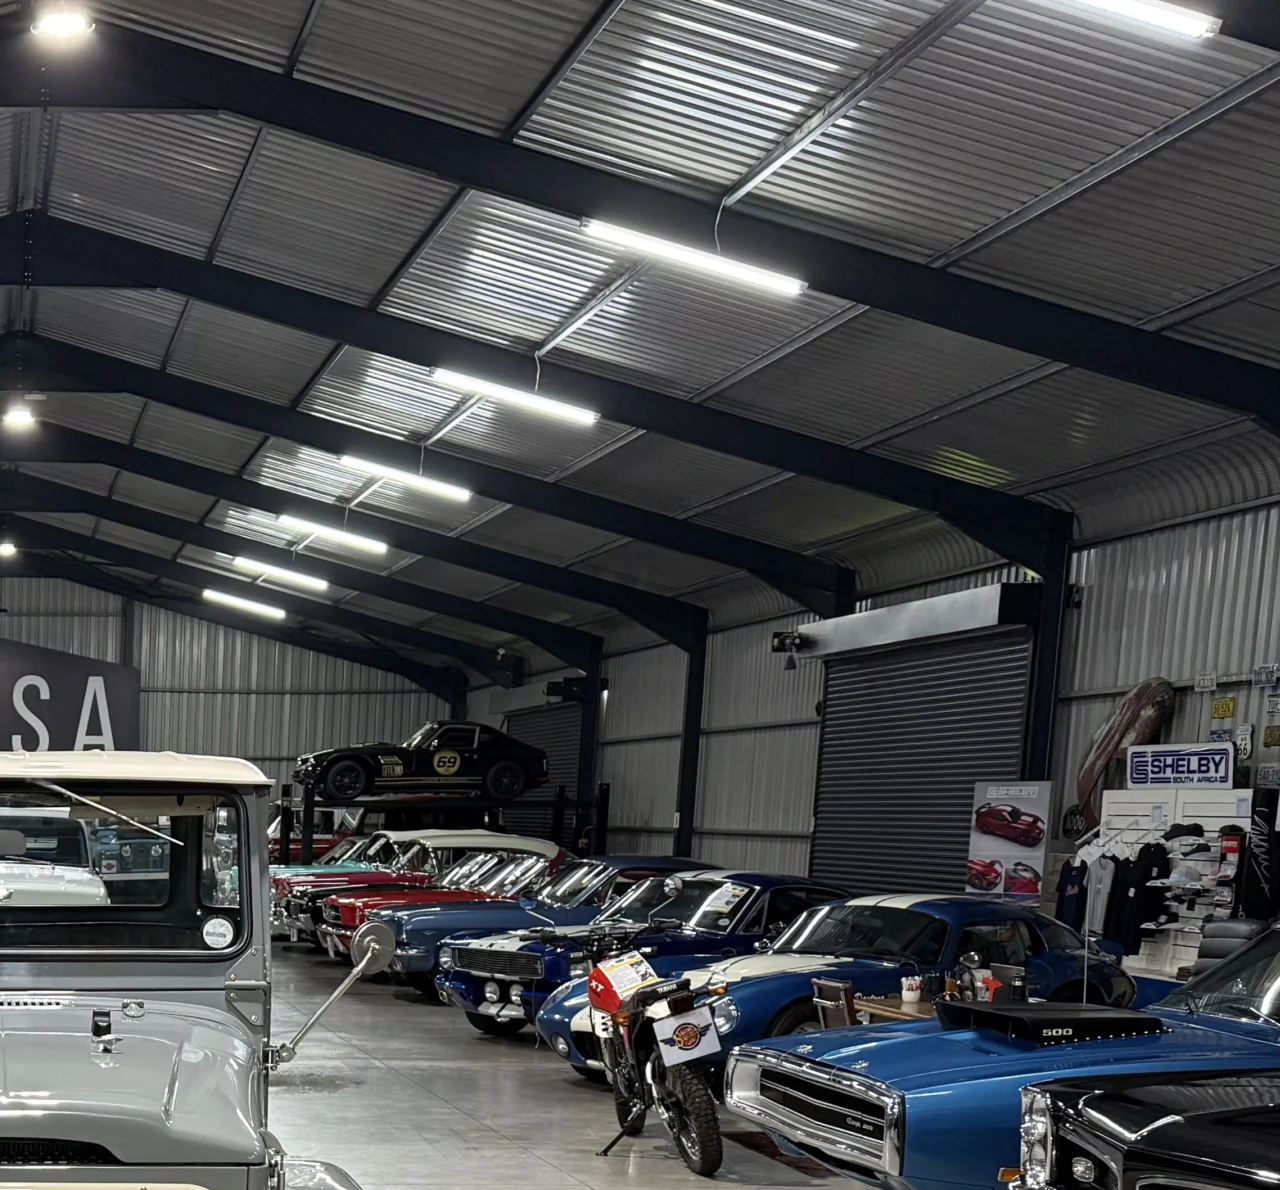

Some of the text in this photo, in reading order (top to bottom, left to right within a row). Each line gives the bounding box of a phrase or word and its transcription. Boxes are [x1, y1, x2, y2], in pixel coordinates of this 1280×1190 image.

[1237, 742, 1248, 756] 66
[436, 756, 458, 768] 69
[1150, 756, 1225, 775] SHELBY
[1172, 776, 1219, 784] SOUTH AFRICA
[589, 979, 605, 992] XT
[656, 983, 678, 994] YAMAHA
[1042, 1028, 1073, 1037] 500
